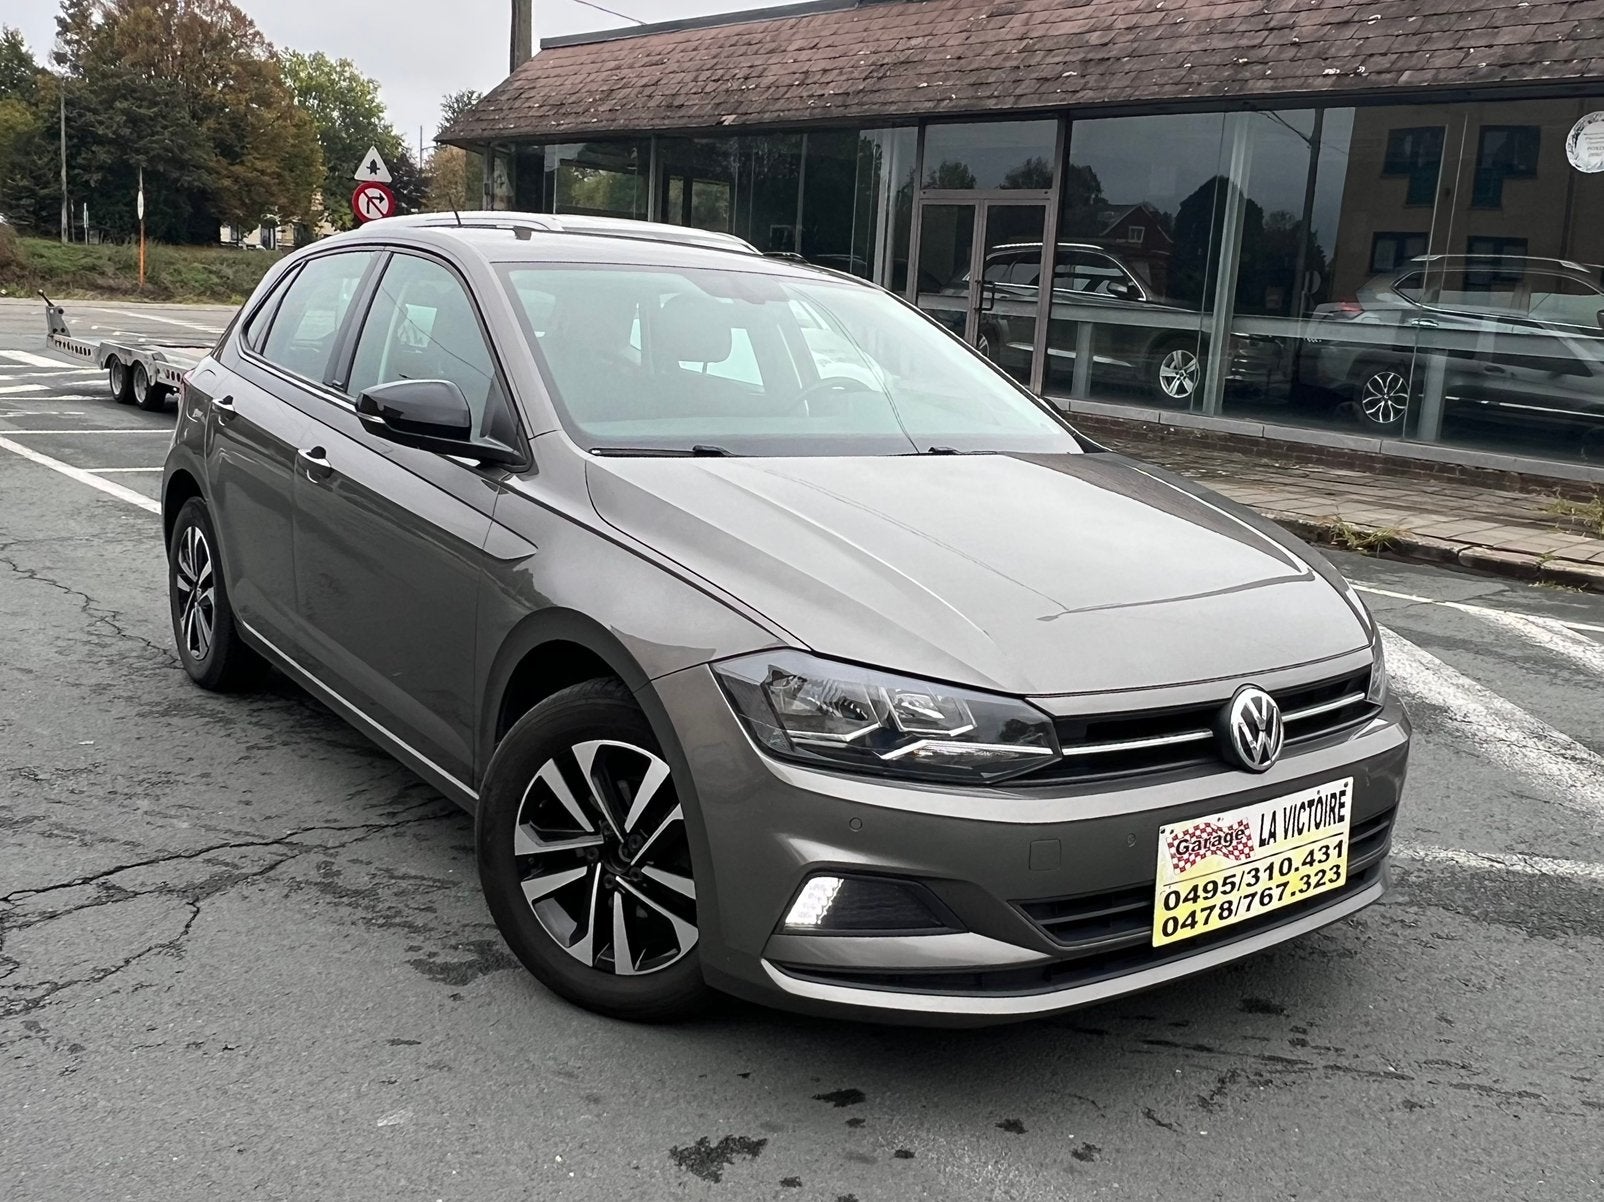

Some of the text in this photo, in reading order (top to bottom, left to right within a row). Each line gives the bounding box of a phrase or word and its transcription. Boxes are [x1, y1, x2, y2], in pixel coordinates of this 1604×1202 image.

[1233, 690, 1283, 771] VW
[1175, 789, 1347, 856] Garage LA VICTOIRE
[1161, 864, 1342, 937] 0478/767.323
[1163, 840, 1344, 911] 0495/310.431
